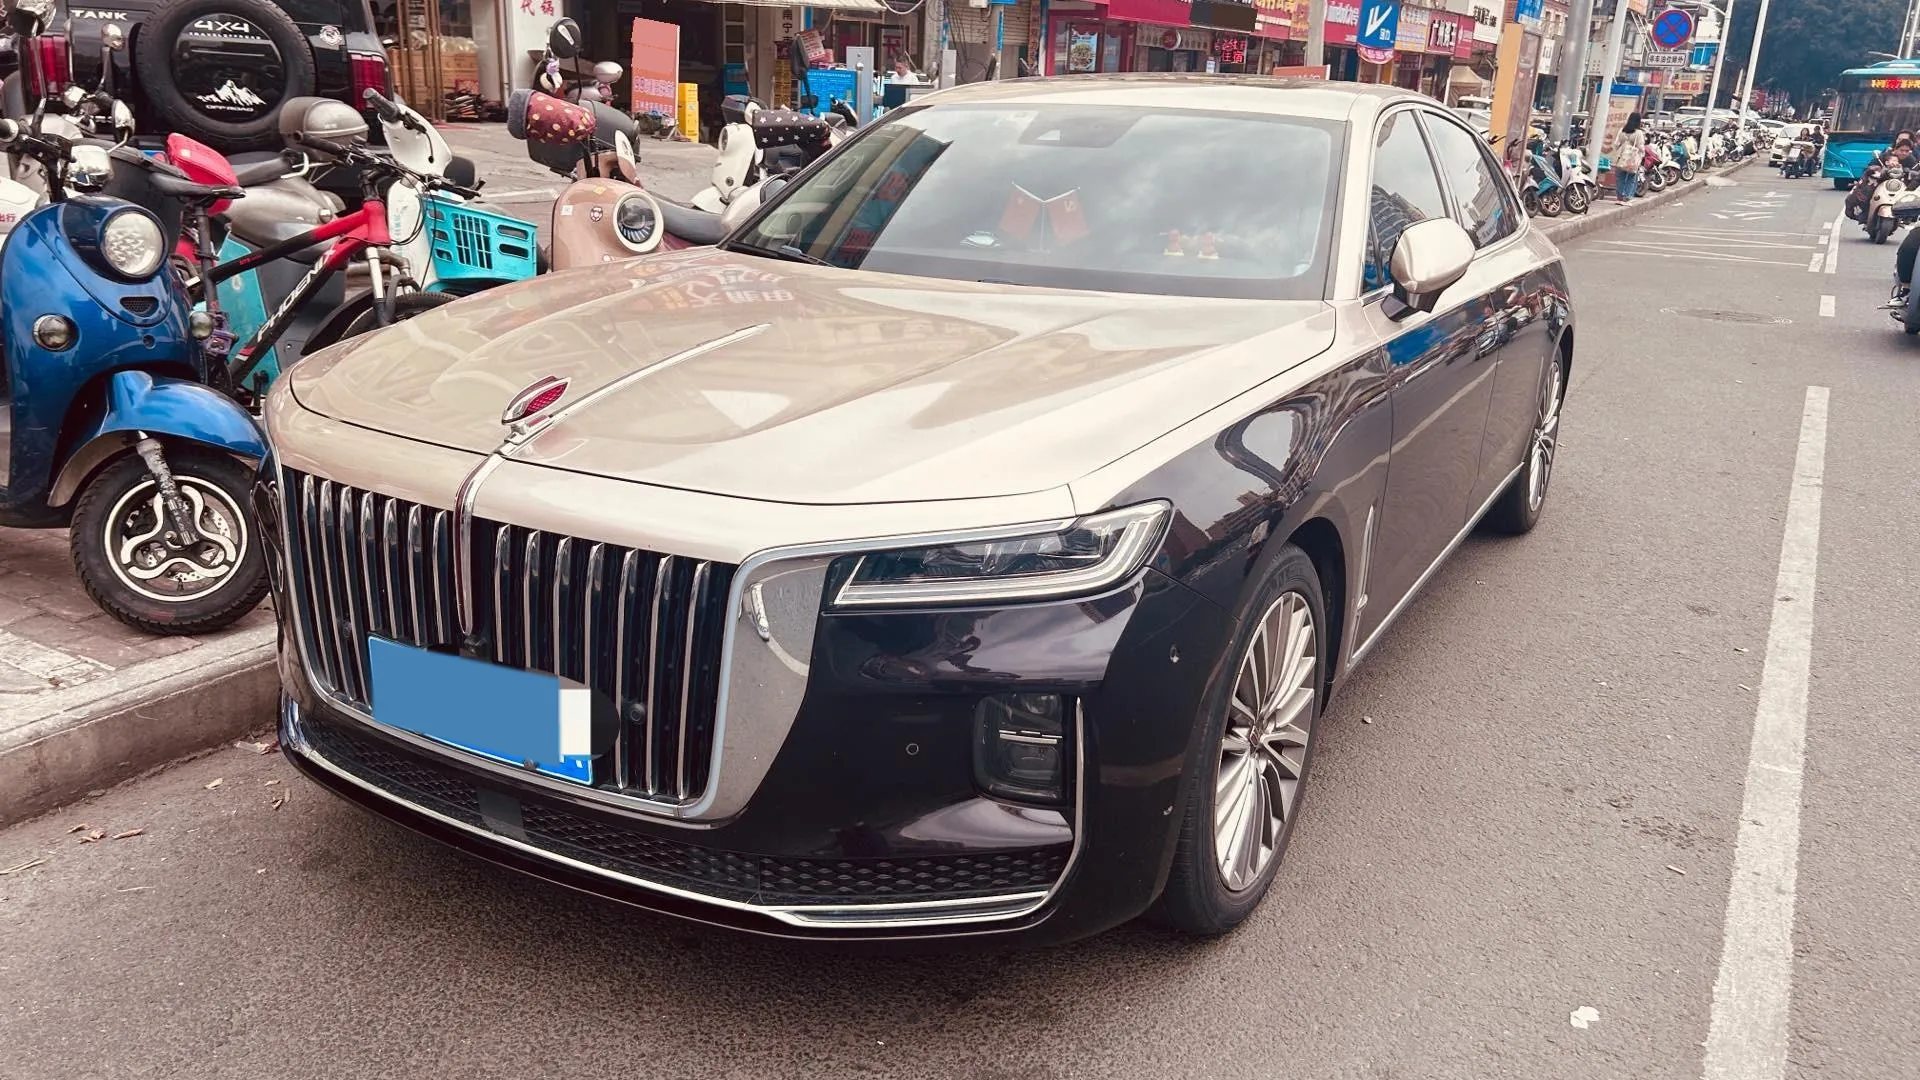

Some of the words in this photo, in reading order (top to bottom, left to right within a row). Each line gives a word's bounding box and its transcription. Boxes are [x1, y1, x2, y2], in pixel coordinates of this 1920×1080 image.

[70, 9, 128, 21] TANK
[194, 20, 250, 33] 4X4
[1649, 54, 1684, 63] 停车泊位除外
